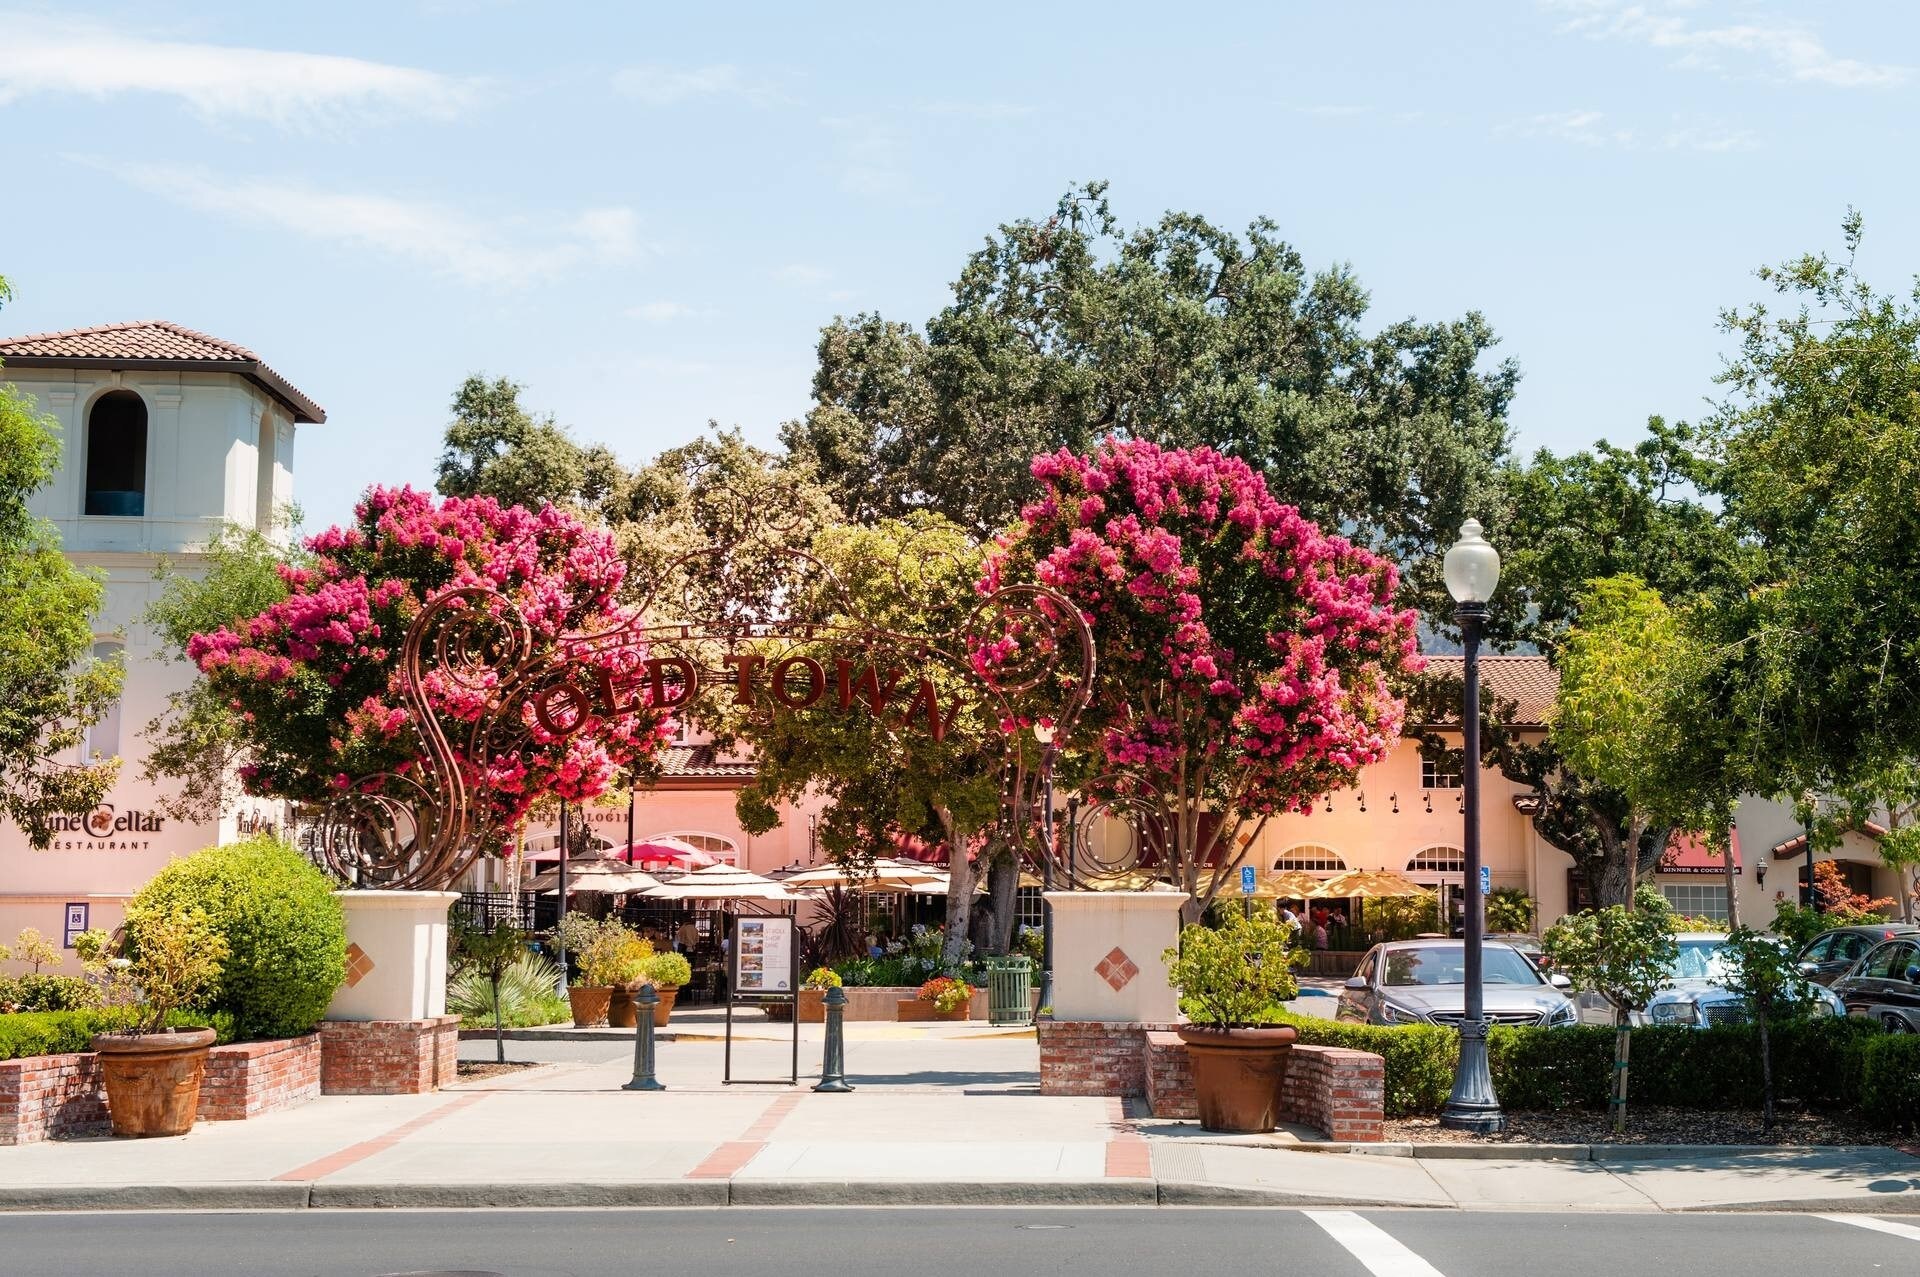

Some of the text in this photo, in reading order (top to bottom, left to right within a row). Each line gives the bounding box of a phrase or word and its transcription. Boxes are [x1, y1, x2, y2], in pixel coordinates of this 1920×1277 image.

[535, 655, 968, 744] OLD TOWN
[83, 803, 165, 838] Cellar
[45, 841, 149, 850] ESTAURANT
